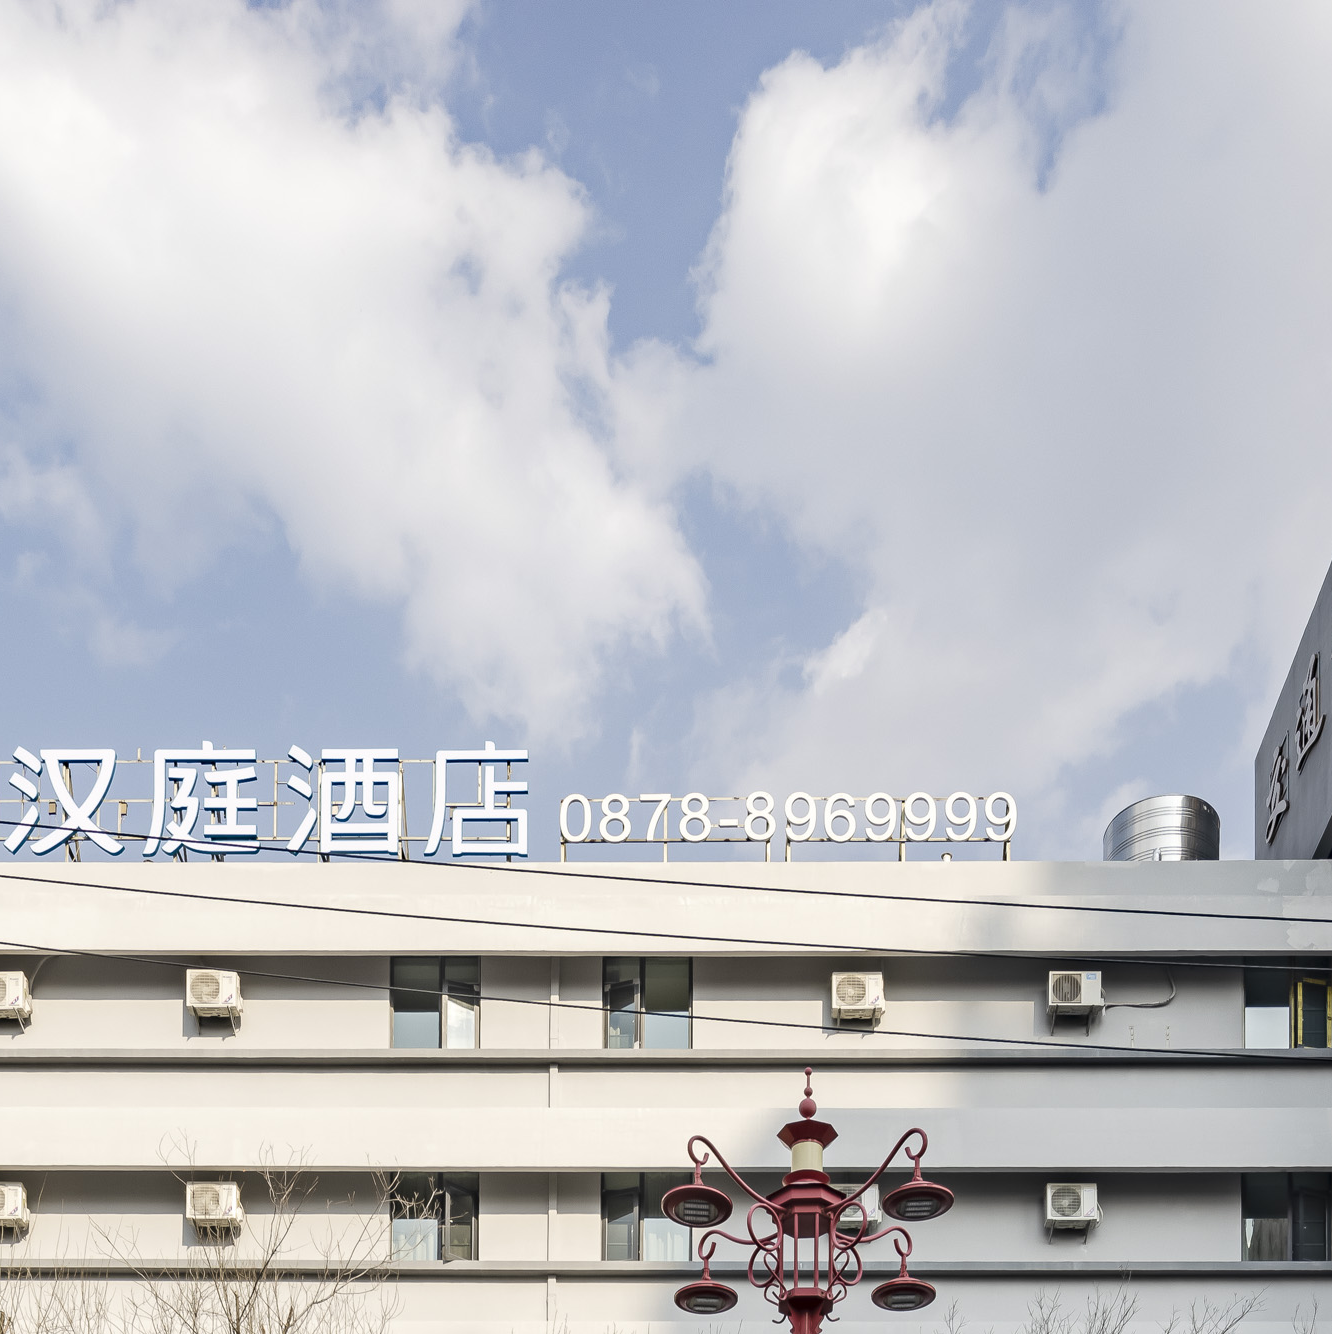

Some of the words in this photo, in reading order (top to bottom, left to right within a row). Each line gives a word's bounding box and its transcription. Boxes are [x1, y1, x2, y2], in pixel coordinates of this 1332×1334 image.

[3, 741, 529, 858] 汉庭酒店
[559, 791, 1018, 843] 0878-8969999
